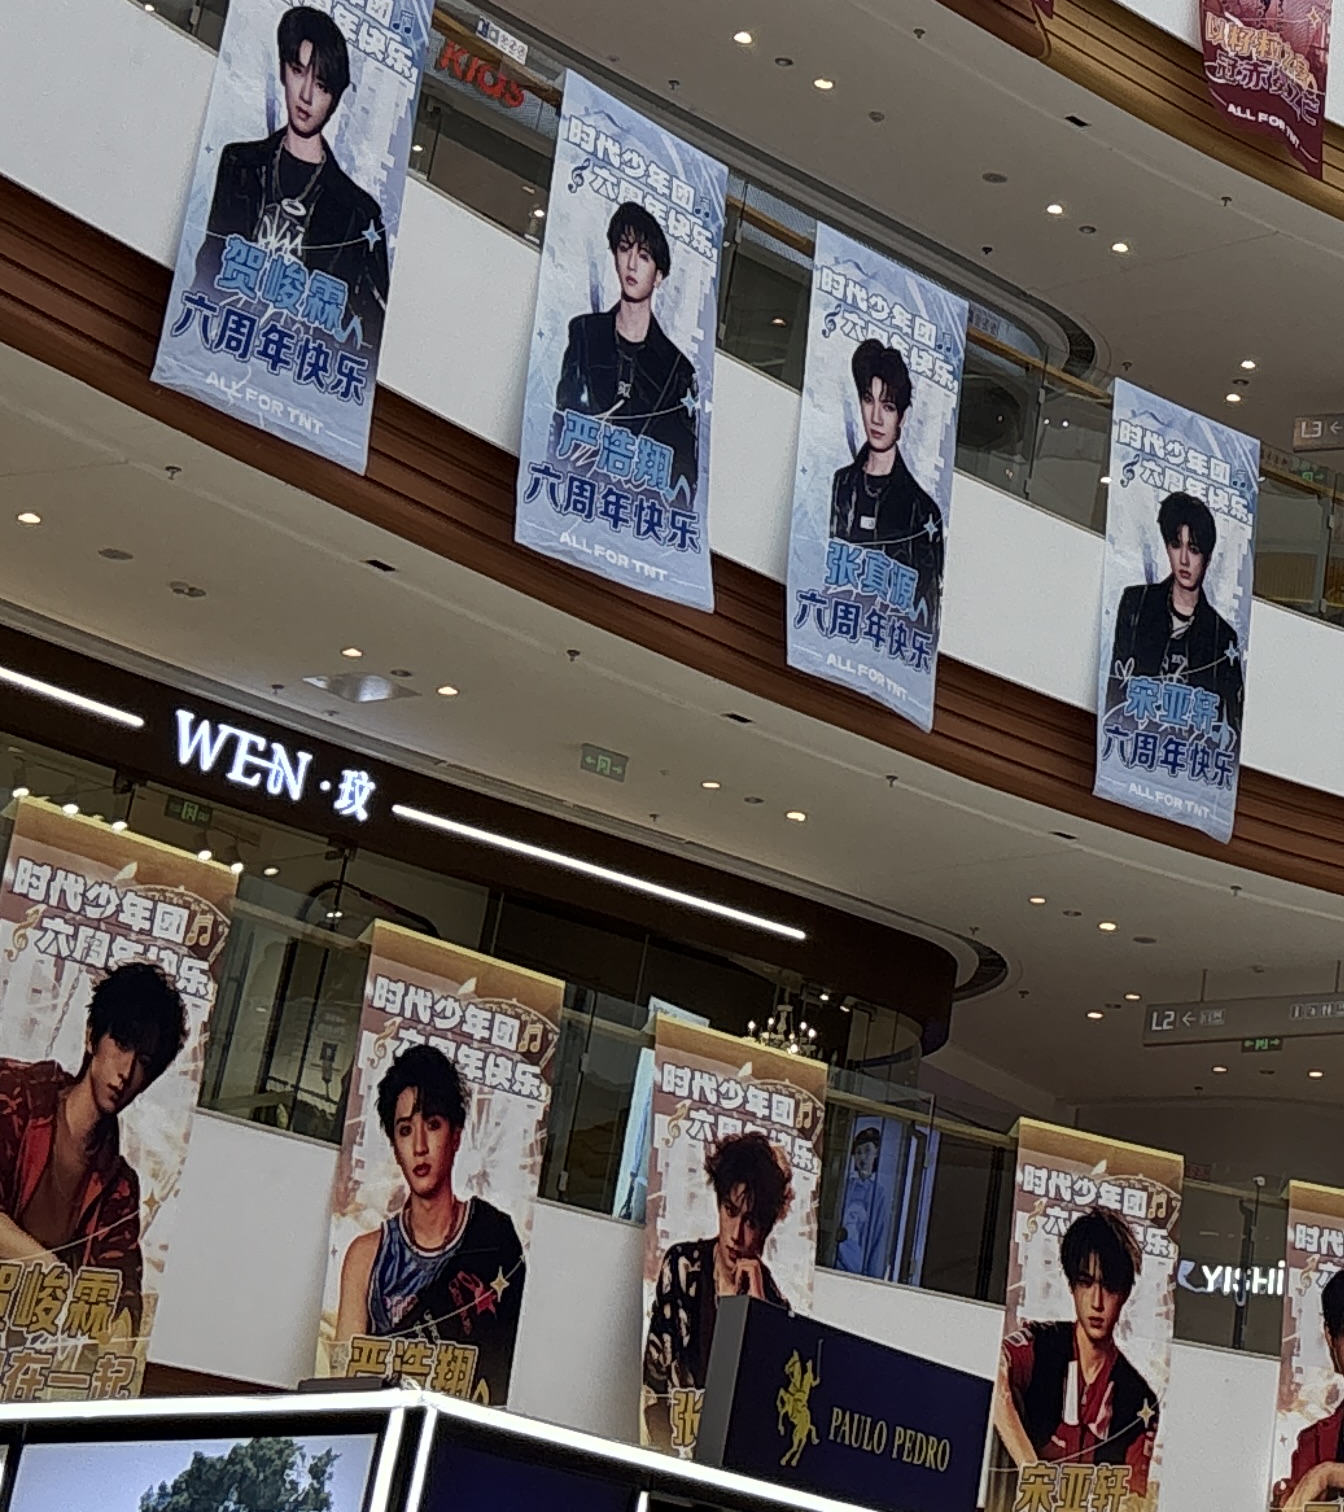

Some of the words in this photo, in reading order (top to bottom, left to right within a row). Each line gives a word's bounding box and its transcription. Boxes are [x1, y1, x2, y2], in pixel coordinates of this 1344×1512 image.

[568, 116, 693, 210] 时代少年团
[220, 232, 346, 336] 贺峻霖
[820, 268, 934, 349] 时代少年团
[173, 286, 368, 409] 六周年快乐
[560, 411, 671, 494] 严浩翔
[1118, 421, 1229, 491] 时代少年团
[1301, 421, 1323, 438] L3
[527, 458, 696, 552] 六周年快乐
[559, 530, 593, 556] ALL
[595, 544, 629, 569] FOR
[633, 558, 666, 583] TNT
[826, 537, 916, 613] 张真源
[795, 595, 931, 668] 六周年快乐
[1127, 675, 1218, 732] 宋亚轩
[1103, 728, 1232, 788] 六周年快乐
[15, 858, 190, 944] 时代少年团
[373, 974, 520, 1046] 时代少年团
[1152, 1010, 1176, 1031] L2
[662, 1063, 795, 1128] 时代少年团
[1023, 1164, 1147, 1215] 时代少年团
[828, 1405, 888, 1455] PAULO
[893, 1426, 952, 1473] PEDRO
